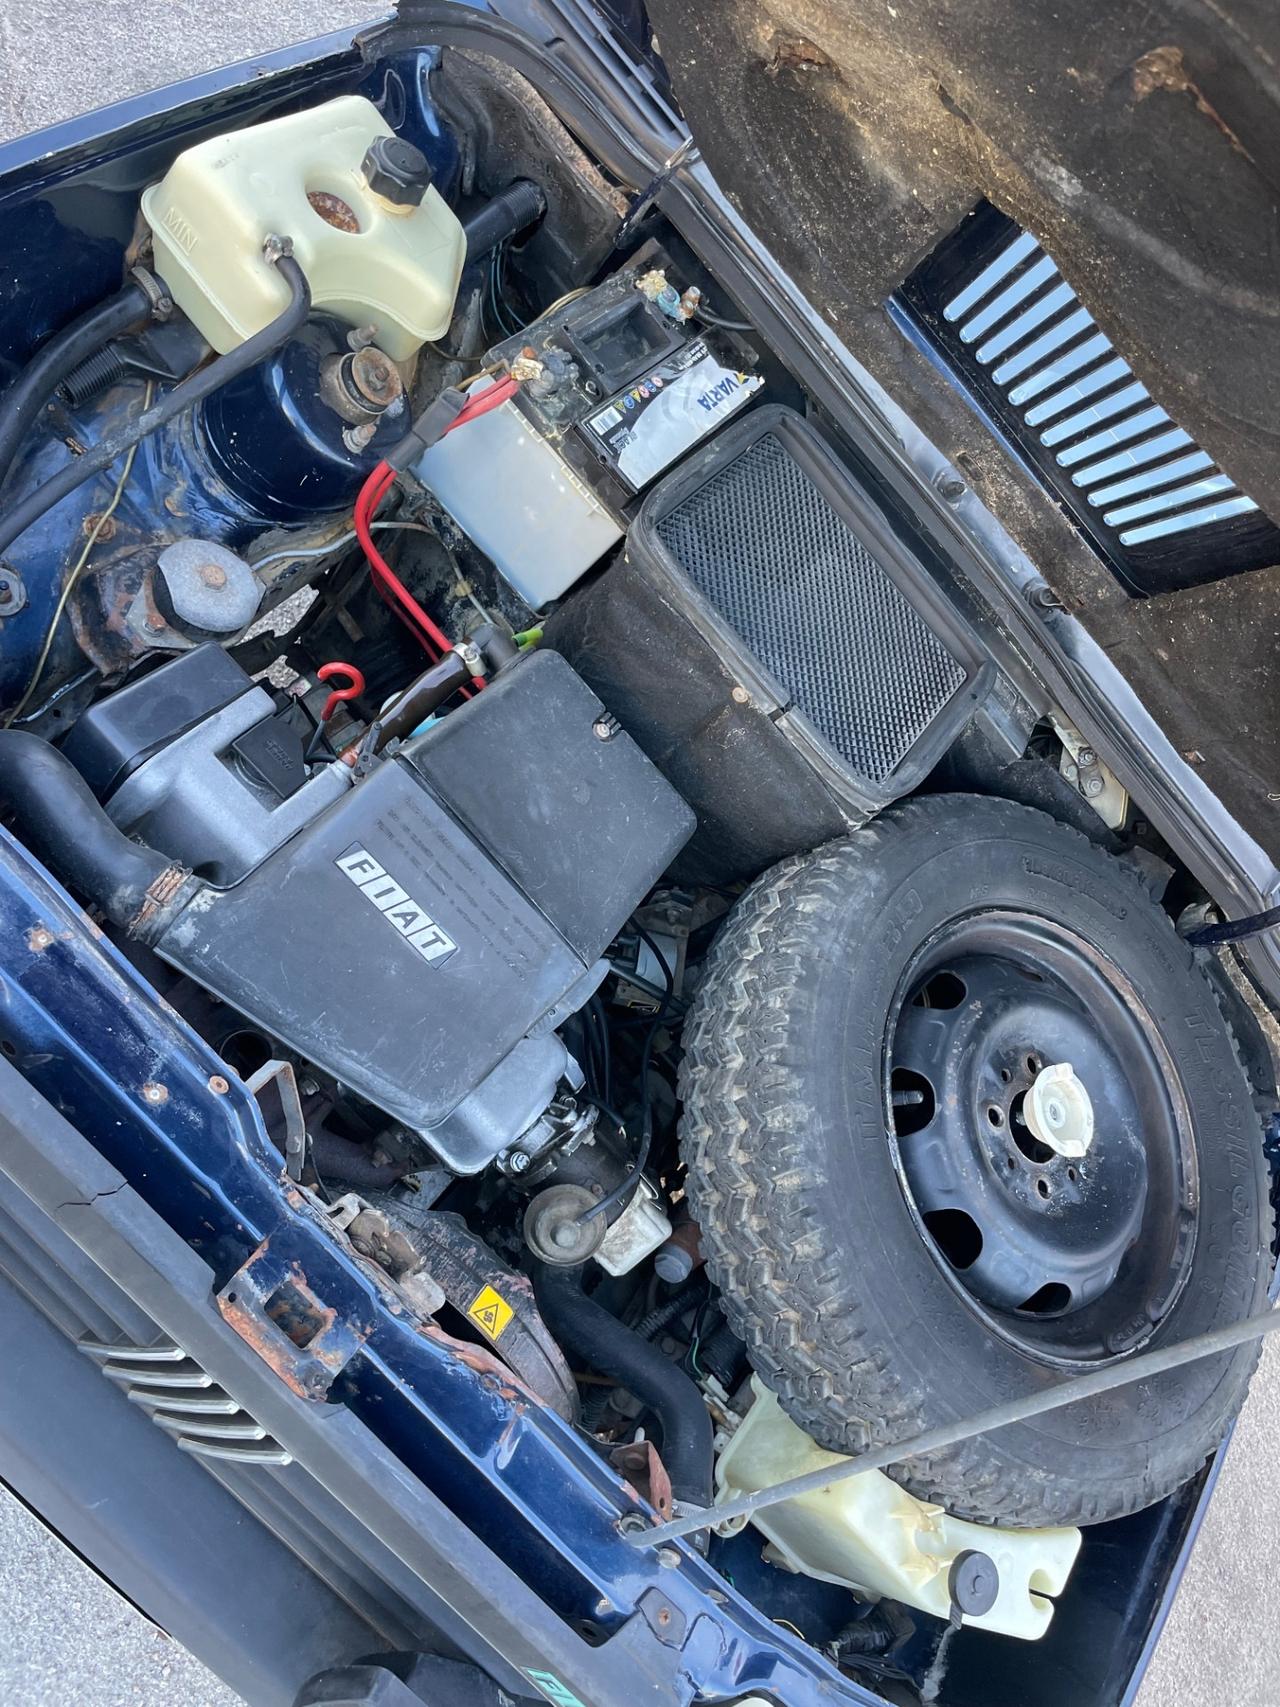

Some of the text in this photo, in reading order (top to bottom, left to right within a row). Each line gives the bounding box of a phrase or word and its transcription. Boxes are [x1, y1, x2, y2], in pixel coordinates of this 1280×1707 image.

[163, 207, 199, 250] MIN
[697, 377, 739, 412] VARTA
[343, 854, 450, 955] FIAT
